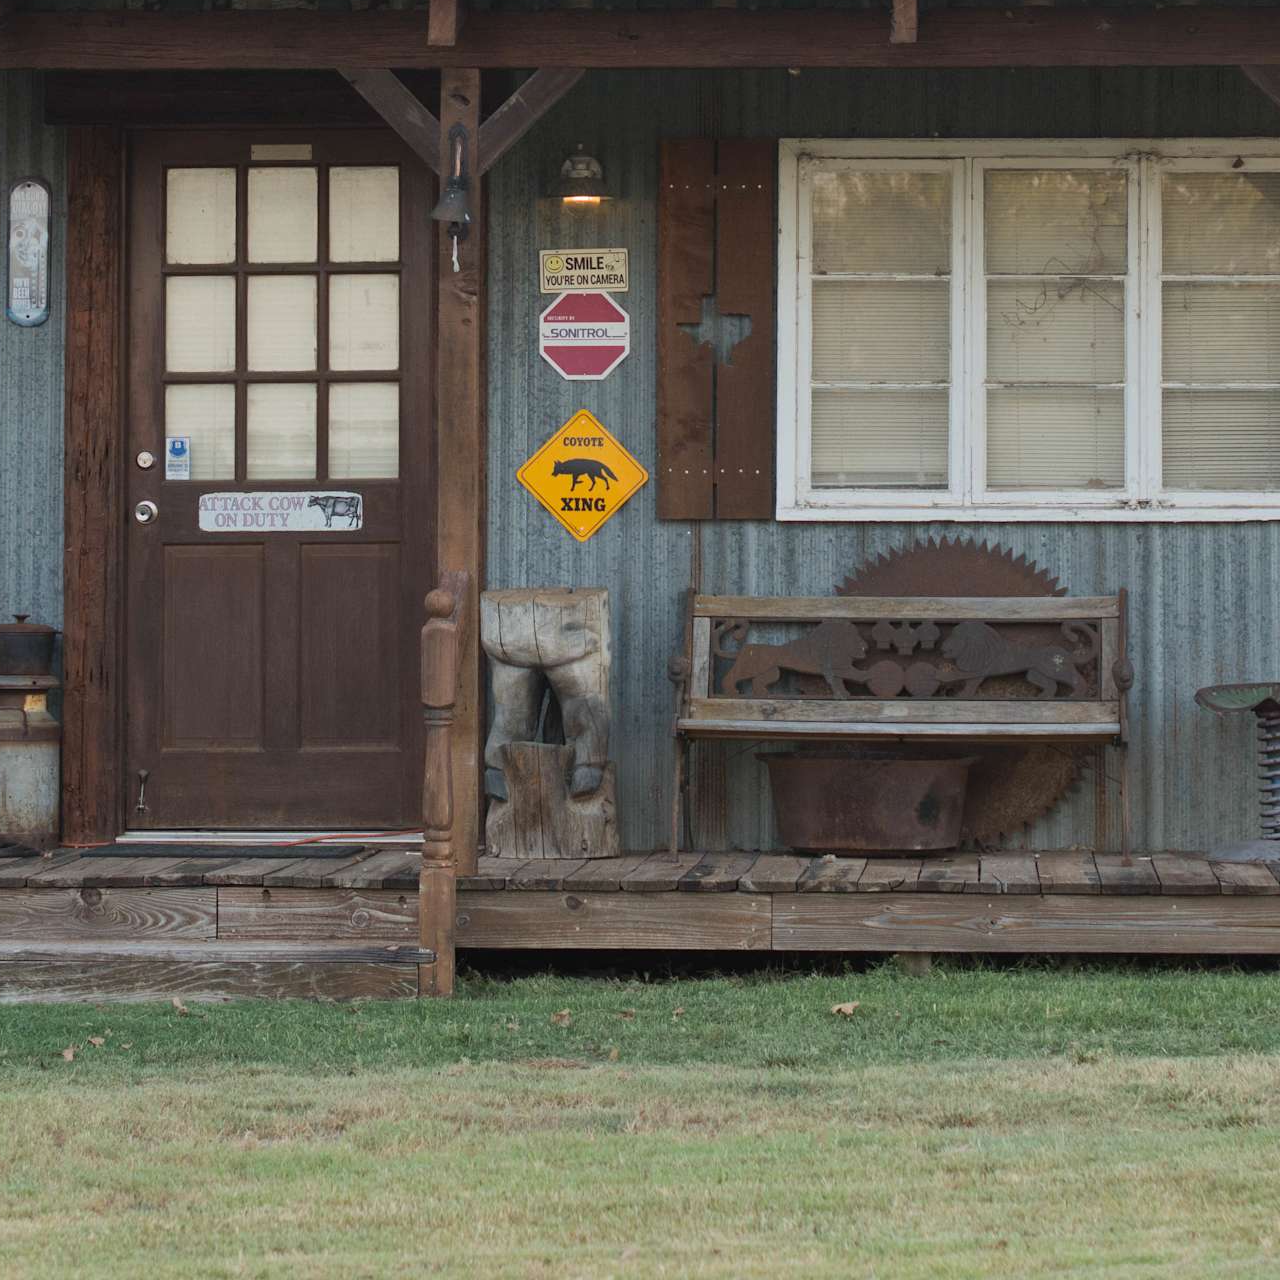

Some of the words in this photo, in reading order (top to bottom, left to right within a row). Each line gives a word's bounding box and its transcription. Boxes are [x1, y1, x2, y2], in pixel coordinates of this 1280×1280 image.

[565, 256, 604, 270] SMILE
[545, 275, 575, 286] YOU'RE
[577, 274, 589, 285] ON
[590, 273, 625, 285] CAMERA
[550, 327, 610, 338] SONITROL
[563, 437, 605, 447] COYOTE
[199, 497, 264, 511] ATTACK
[268, 497, 306, 511] COW
[561, 497, 606, 511] XING
[215, 513, 237, 528] ON
[242, 513, 290, 528] DUTY
